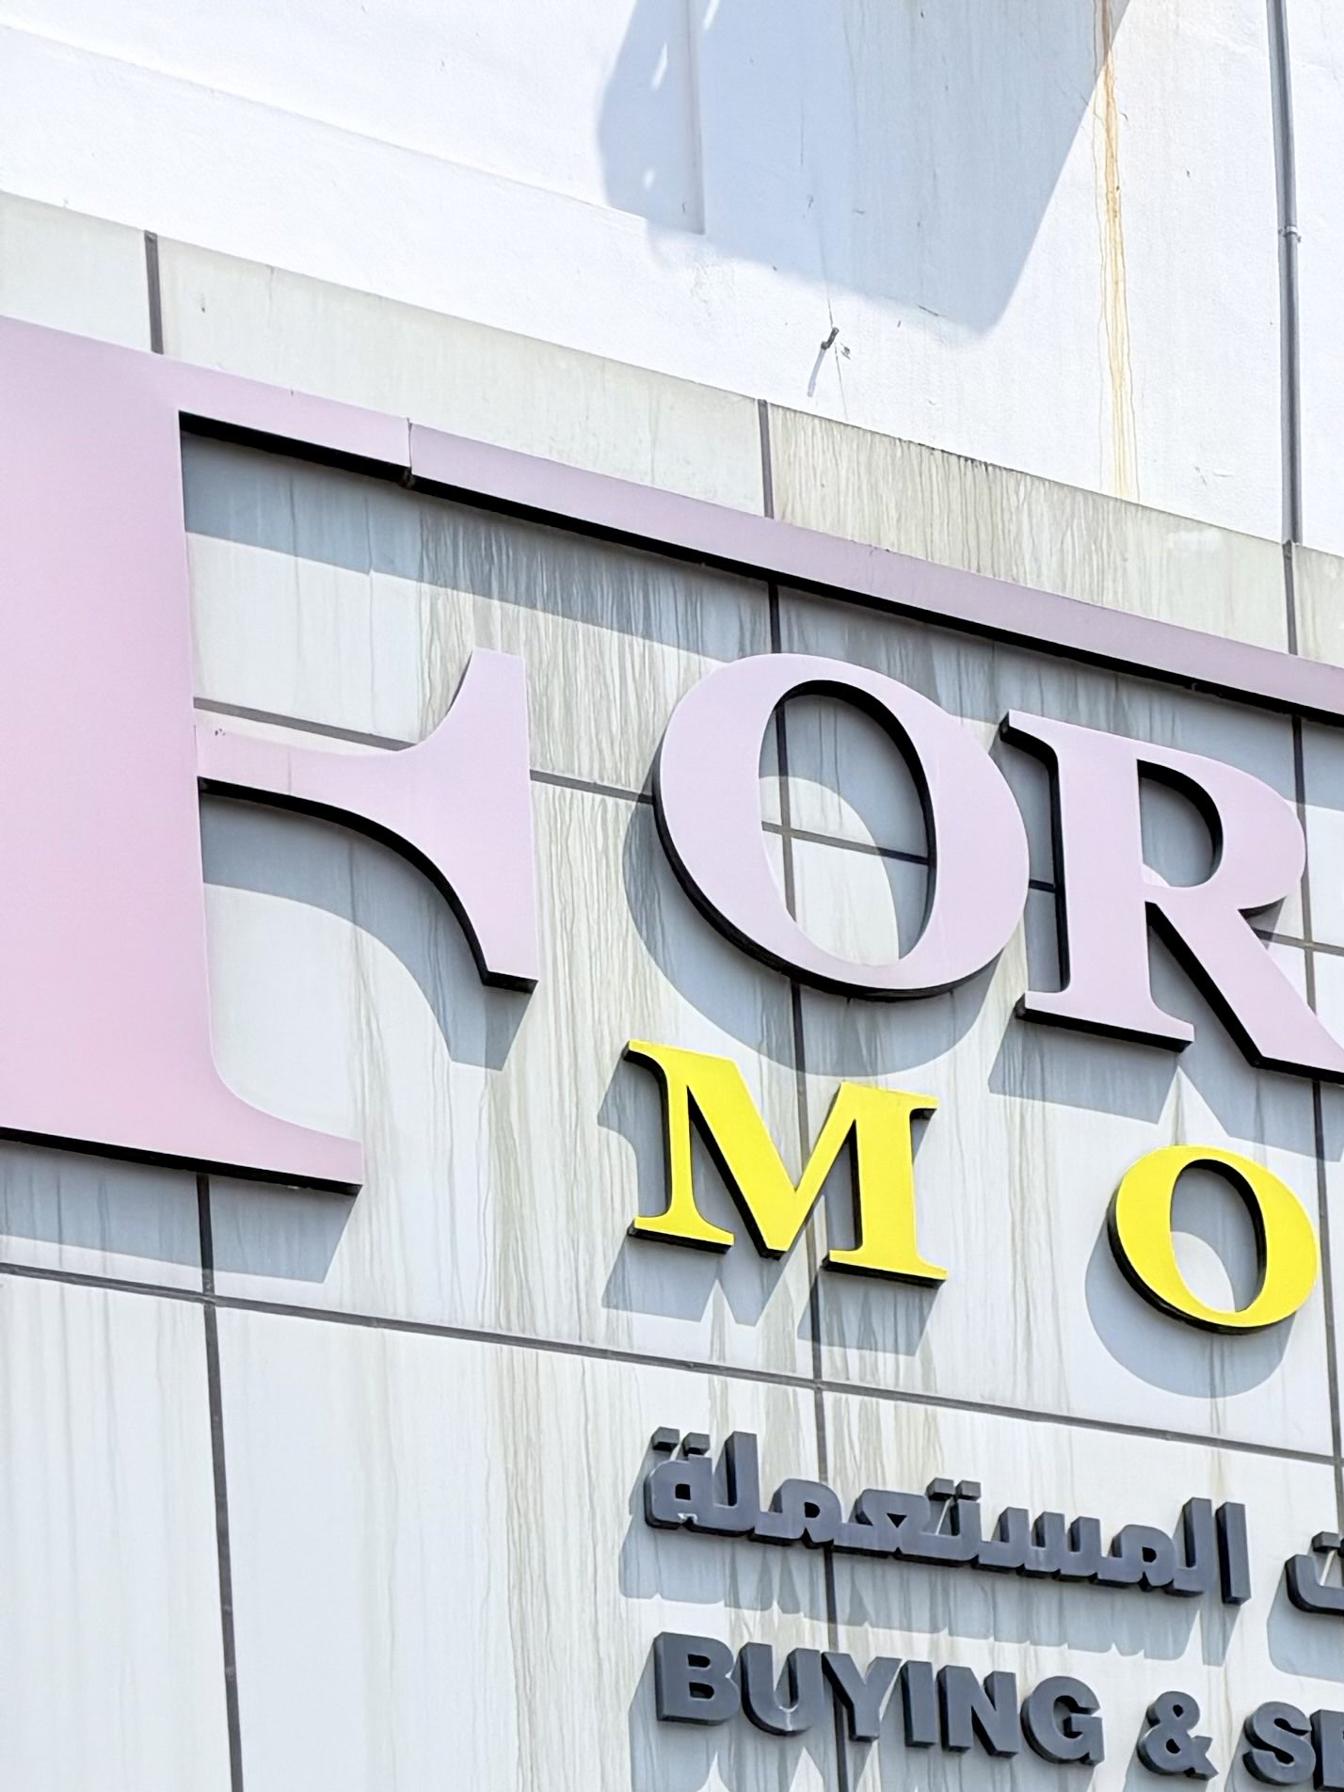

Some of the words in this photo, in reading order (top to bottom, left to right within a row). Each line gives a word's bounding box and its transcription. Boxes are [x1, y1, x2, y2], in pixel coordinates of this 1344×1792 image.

[644, 1426, 1251, 1604] المستعملة
[653, 1631, 1105, 1766] BUYING
[1137, 1690, 1218, 1780] &
